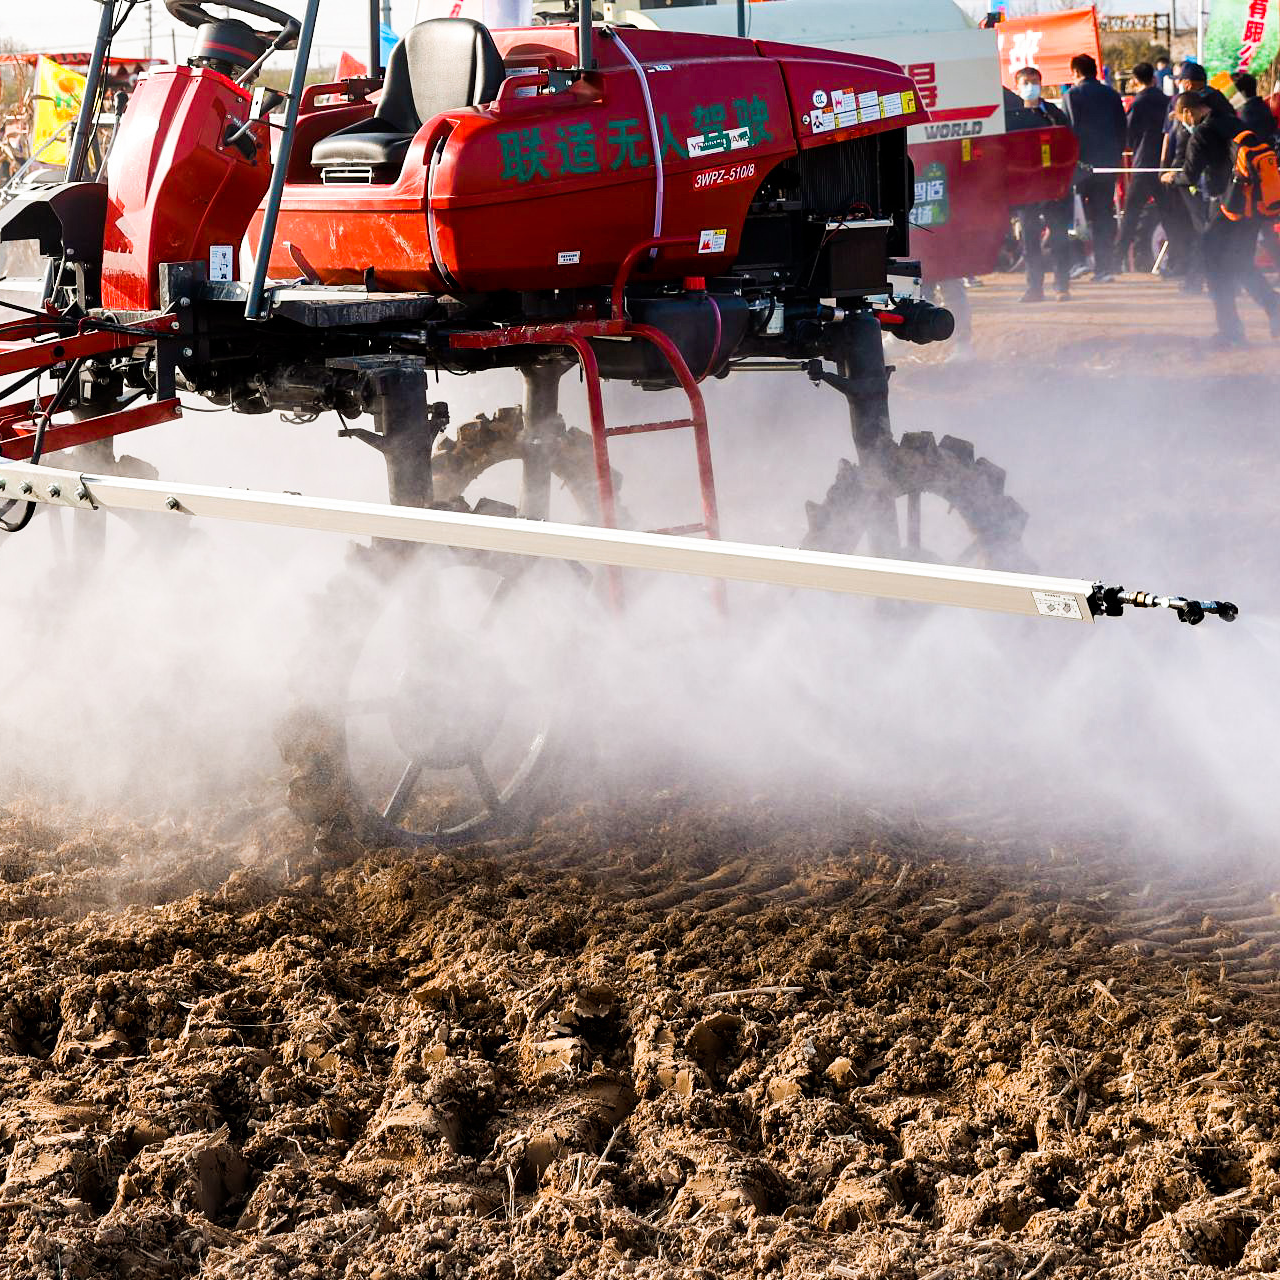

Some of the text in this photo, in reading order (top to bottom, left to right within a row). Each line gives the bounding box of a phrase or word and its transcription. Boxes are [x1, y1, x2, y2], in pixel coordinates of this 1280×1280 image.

[496, 95, 773, 183] 联适无人驾驶
[924, 121, 983, 140] WORLD
[694, 163, 755, 188] 3WPZ-510/8
